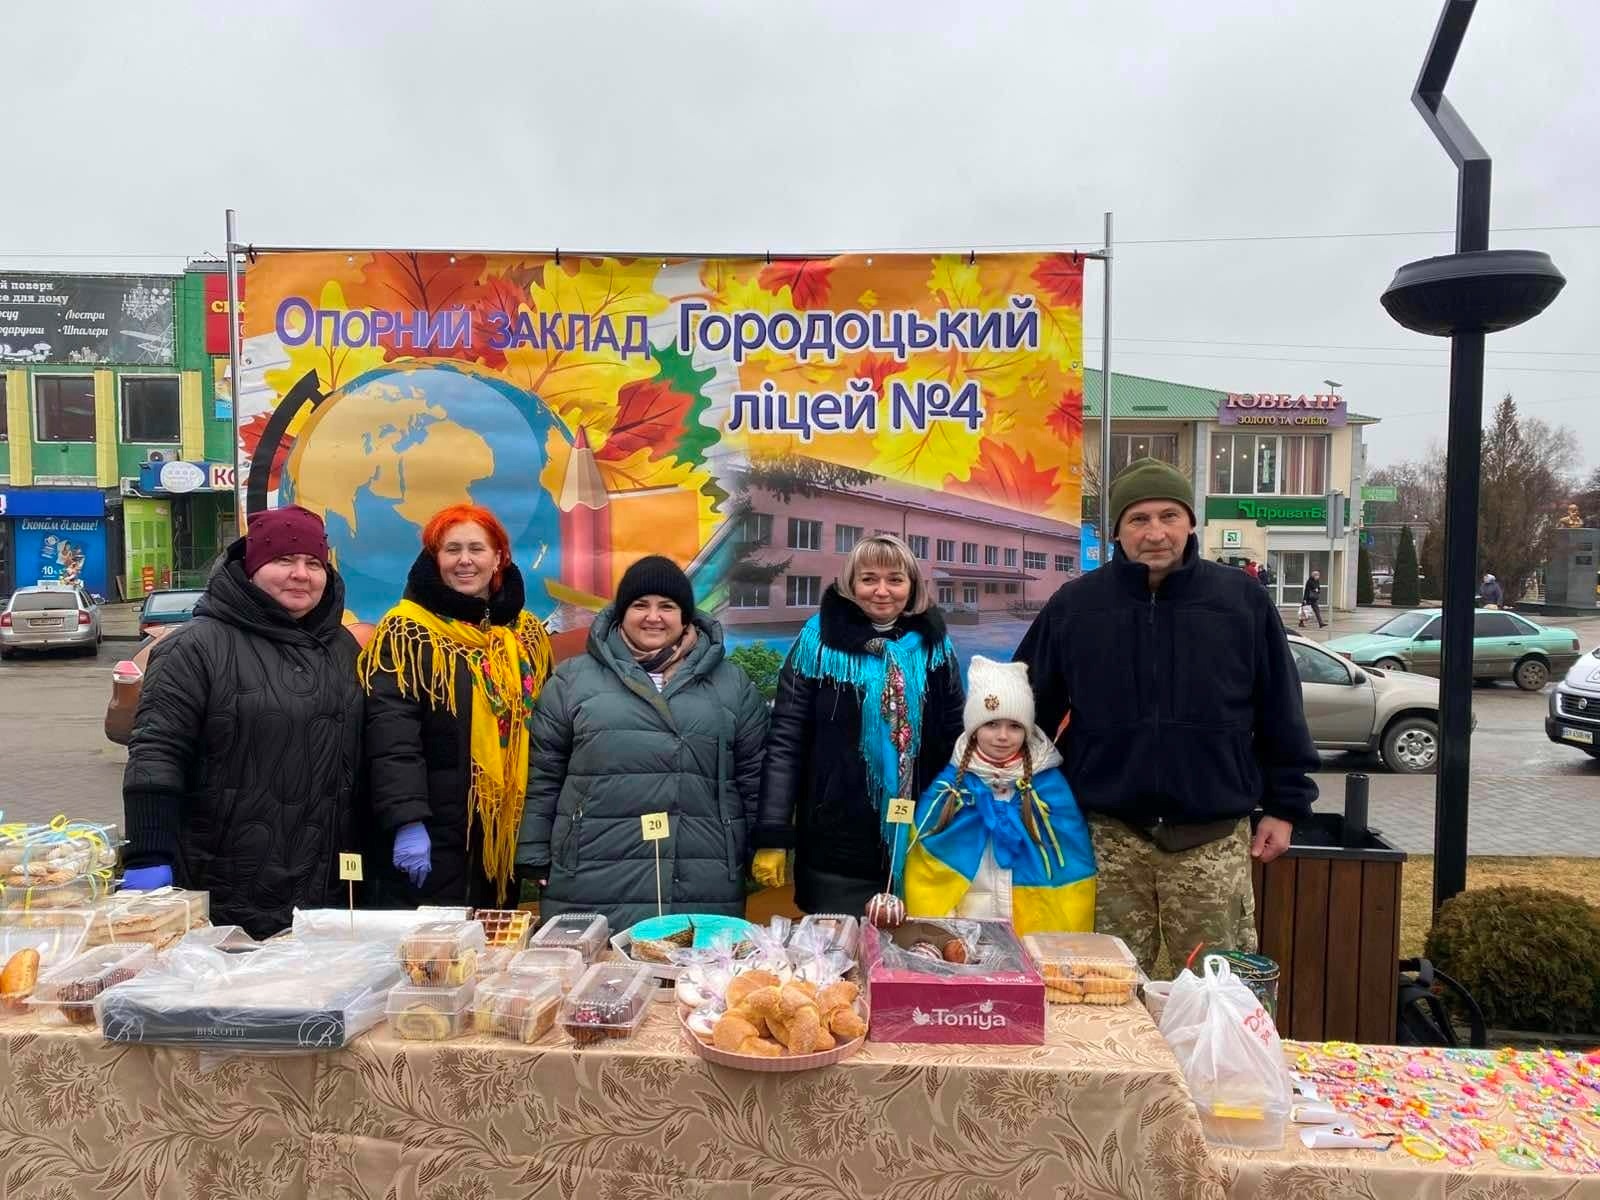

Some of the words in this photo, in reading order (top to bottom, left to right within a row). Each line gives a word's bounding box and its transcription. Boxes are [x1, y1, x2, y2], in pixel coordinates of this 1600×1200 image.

[12, 294, 35, 304] для
[38, 294, 69, 305] дому
[65, 309, 105, 322] Люстри
[62, 325, 109, 338] Шпалери
[678, 296, 1039, 363] Городоцький
[1226, 392, 1343, 410] ЮВЕЛІР
[728, 381, 876, 440] ліцей
[891, 382, 983, 431] №4
[1238, 415, 1276, 425] ЗОЛОТО
[1280, 416, 1292, 425] ТА
[1295, 416, 1329, 425] СРІБЛО
[1256, 506, 1350, 520] ПриватБа
[894, 805, 908, 815] 25
[648, 819, 662, 831] 20
[345, 859, 357, 872] 10
[931, 1000, 1006, 1030] Toniya
